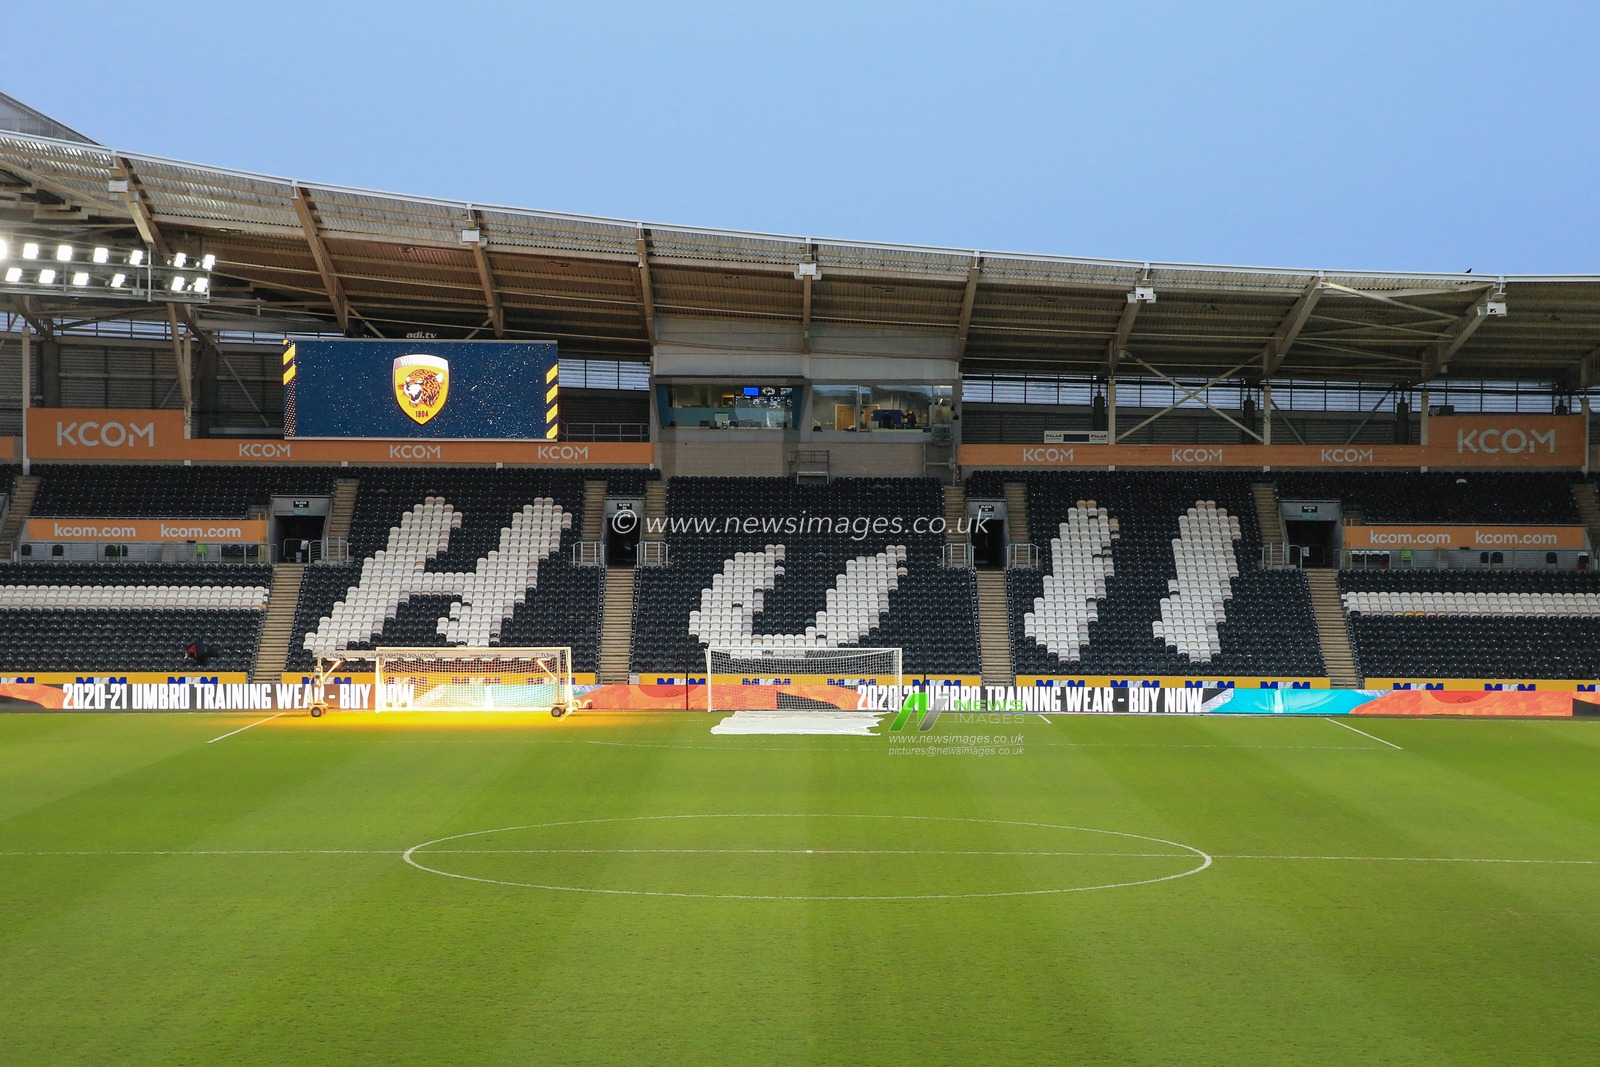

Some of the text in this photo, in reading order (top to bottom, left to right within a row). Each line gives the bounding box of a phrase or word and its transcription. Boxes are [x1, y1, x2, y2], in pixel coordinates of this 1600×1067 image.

[406, 331, 437, 339] adi.tv
[416, 410, 429, 418] 1904
[56, 421, 155, 448] KCOM
[1457, 428, 1556, 454] KCOM
[239, 443, 291, 458] KCOM
[389, 445, 441, 460] KCOM
[537, 445, 589, 460] KCOM
[1023, 448, 1074, 462] KCOM
[1171, 448, 1223, 463] KCOM
[1321, 448, 1374, 463] KCOM
[54, 523, 242, 538] kcom.com kcom.com
[1369, 530, 1557, 545] kcom.com kcom.com
[62, 683, 127, 710] 2020-21
[132, 682, 191, 710] UMBRO
[194, 682, 272, 710] TRAINING
[339, 683, 372, 710] BUY
[925, 684, 982, 711] UMBRO
[985, 685, 1072, 712] TRAINING
[1074, 686, 1114, 712] WEAR
[1129, 686, 1171, 713] BUY
[1173, 687, 1204, 714] NOW
